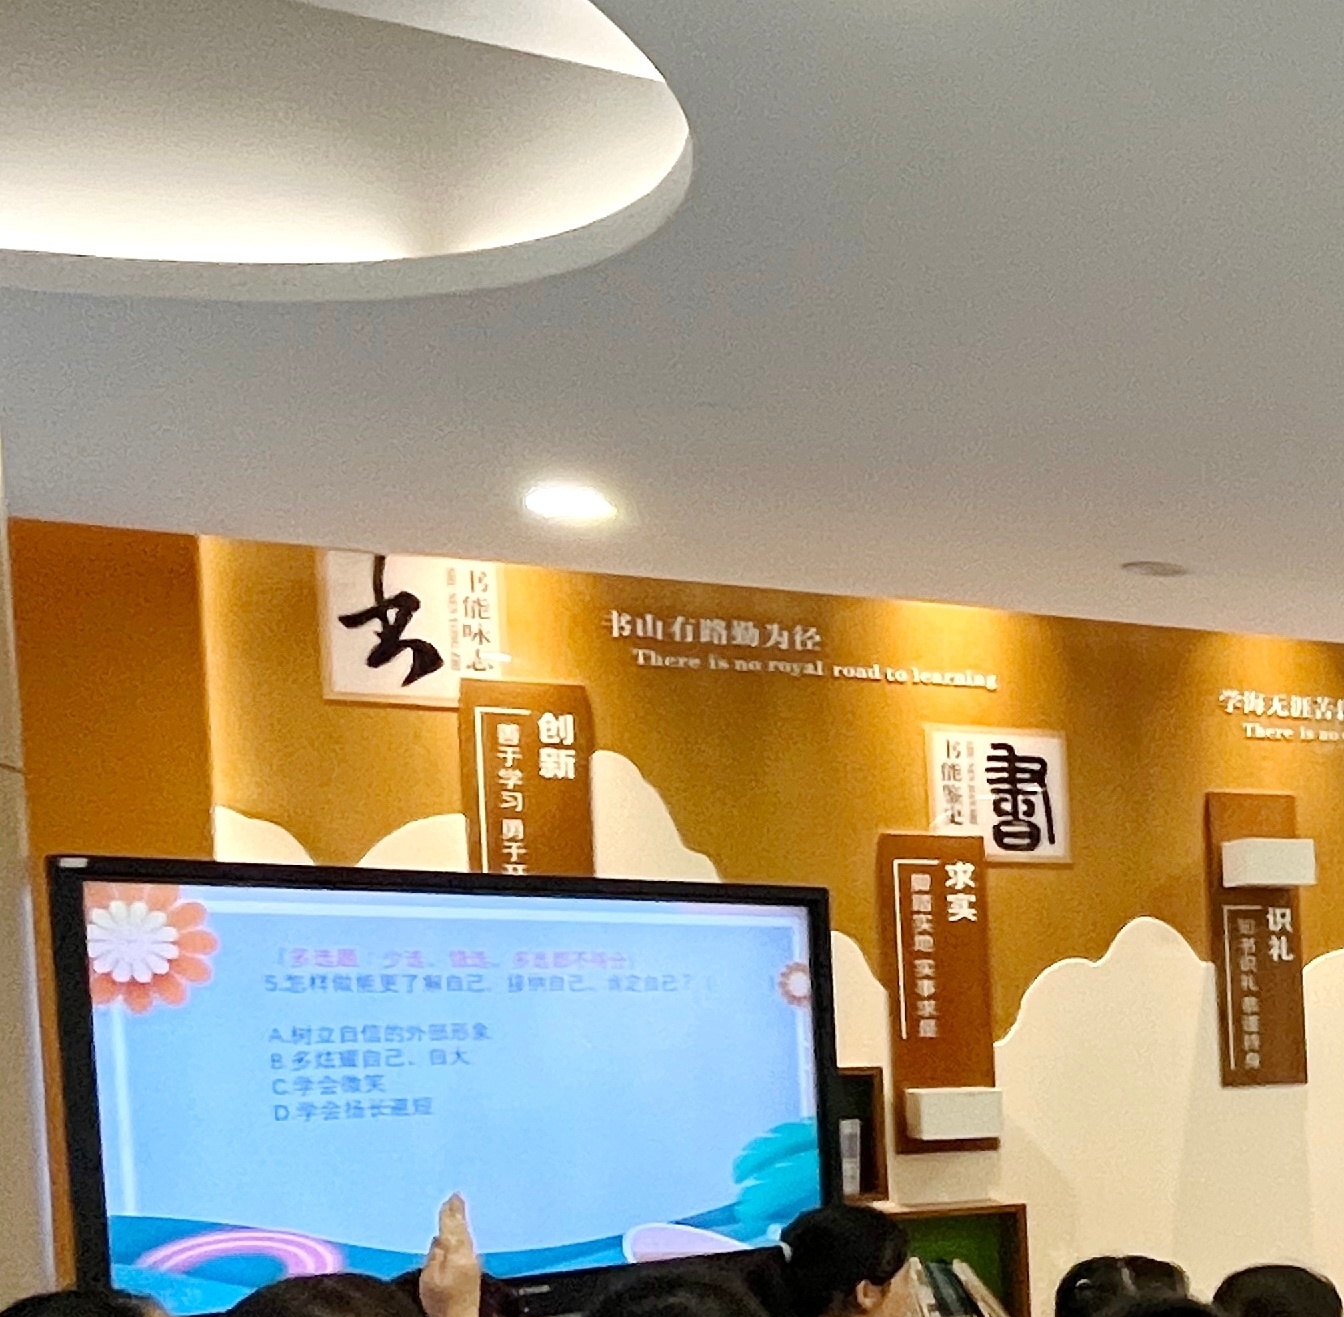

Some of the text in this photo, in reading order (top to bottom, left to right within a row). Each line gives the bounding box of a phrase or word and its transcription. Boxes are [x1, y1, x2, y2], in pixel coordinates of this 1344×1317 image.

[604, 609, 822, 652] 书山有路勤为径
[633, 647, 998, 691] There is no royal road to learning
[537, 712, 577, 780] 创新
[1243, 722, 1295, 739] There
[1300, 726, 1315, 741] is
[1319, 729, 1340, 742] no
[496, 722, 524, 813] 善于学习
[944, 861, 978, 922] 求实
[1266, 906, 1296, 962] 识礼
